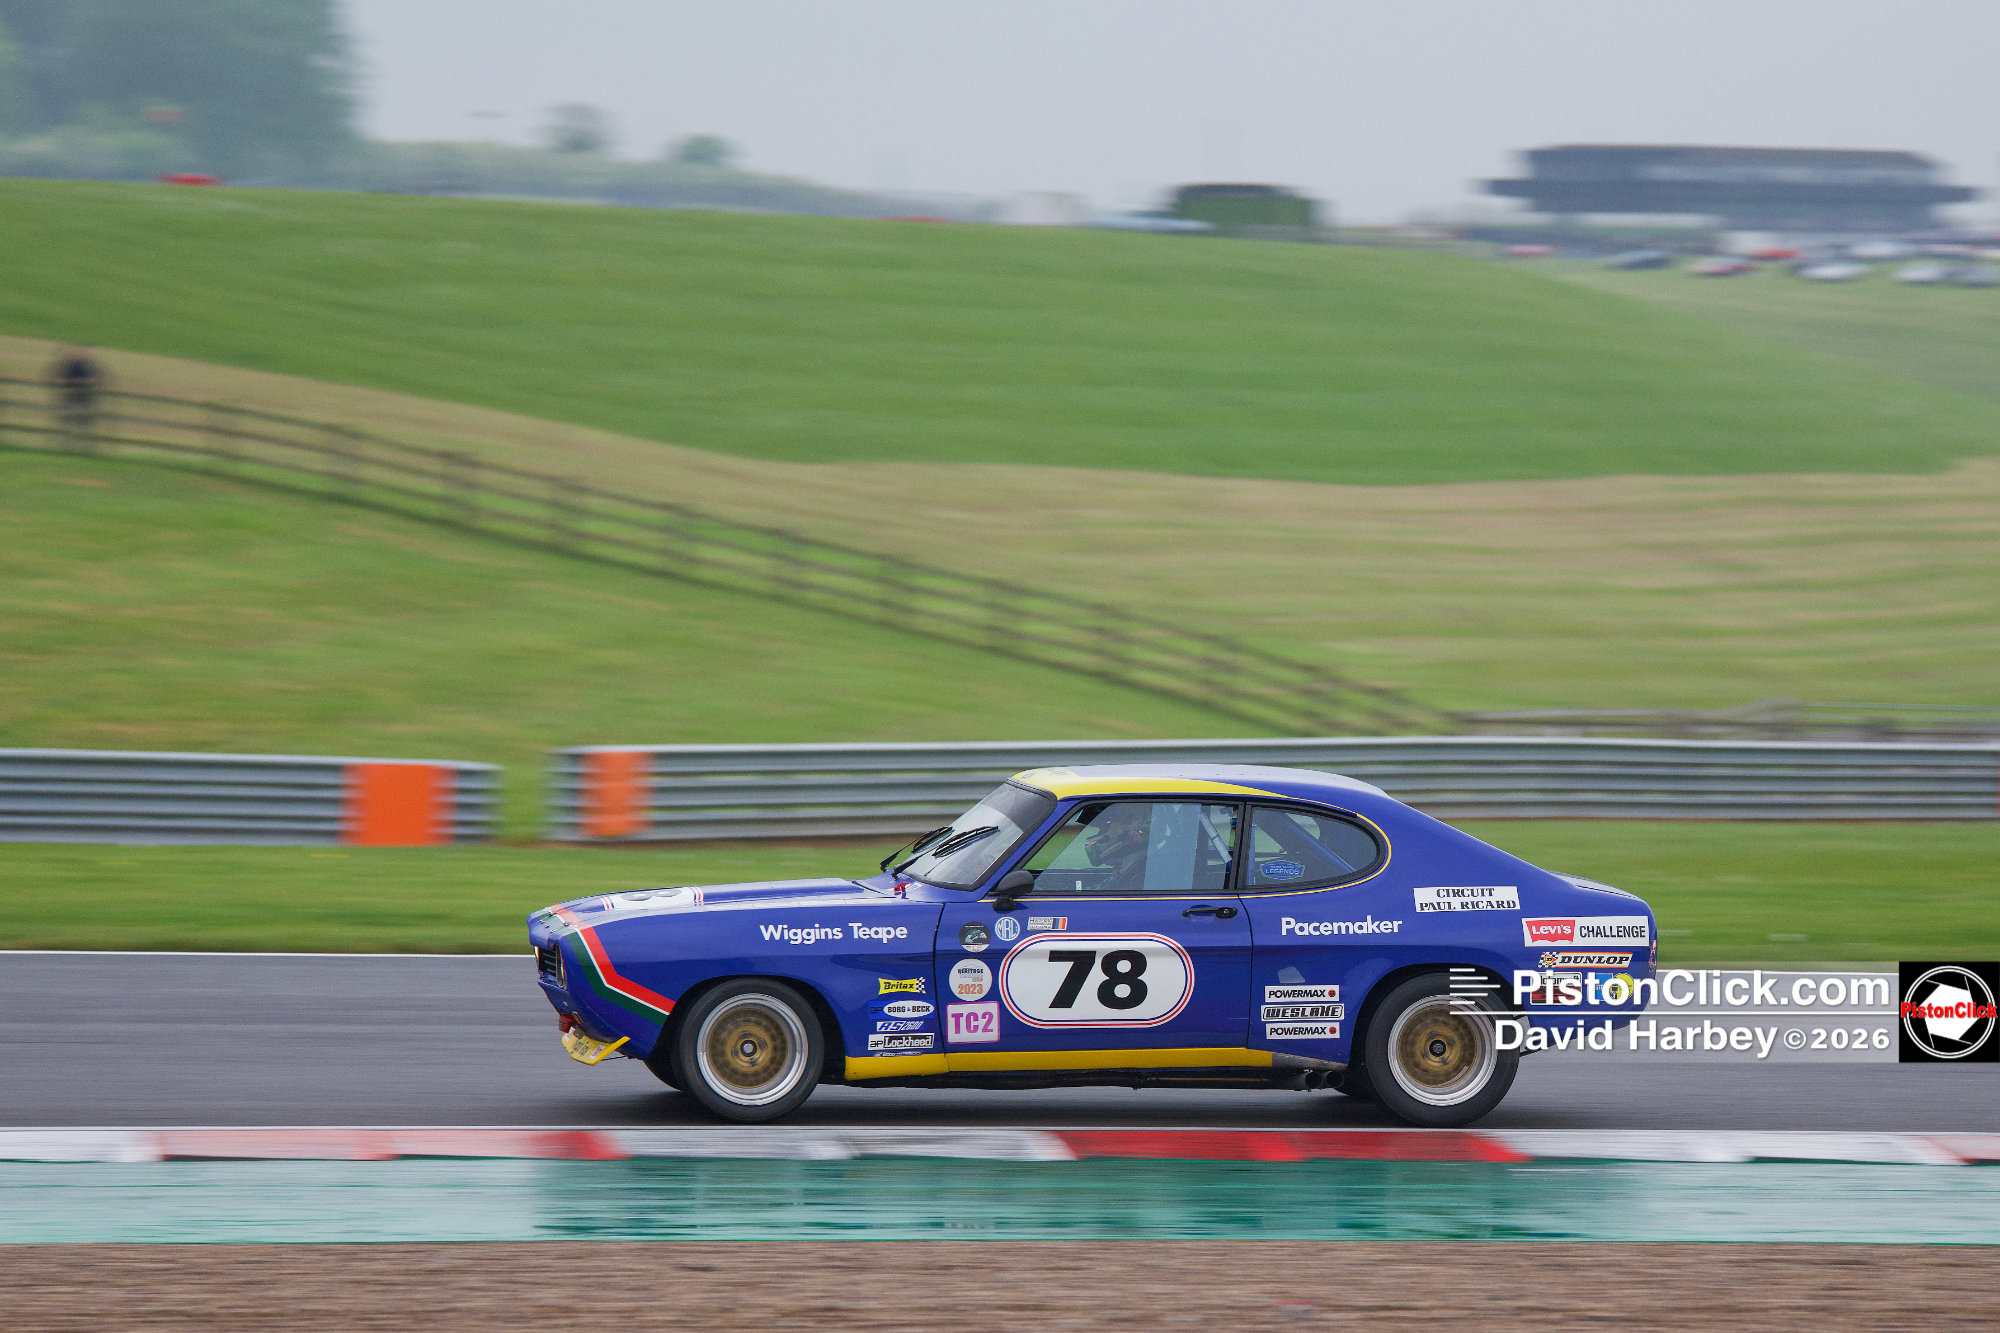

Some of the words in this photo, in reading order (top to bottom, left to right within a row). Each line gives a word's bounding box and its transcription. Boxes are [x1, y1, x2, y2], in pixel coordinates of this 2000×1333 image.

[1436, 887, 1495, 898] CIRCUIT
[1419, 901, 1456, 911] PAUL
[1460, 900, 1517, 910] RICARD
[1280, 914, 1403, 936] Pacemaker
[759, 923, 843, 945] Wiggins
[848, 922, 908, 944] Teape
[1579, 925, 1646, 938] CHALLENGE
[1559, 955, 1630, 964] DUNLOP
[883, 981, 914, 990] Britax
[1048, 949, 1148, 1010] 78
[957, 983, 984, 995] 2023
[1268, 989, 1326, 998] POWERMAX
[887, 1005, 905, 1013] BORG
[911, 1005, 931, 1013] BECK
[1265, 1005, 1340, 1018] WESLAKE
[950, 1011, 994, 1035] TC2
[1269, 1026, 1327, 1036] POWERMAX
[884, 1035, 932, 1048] Lockheed
